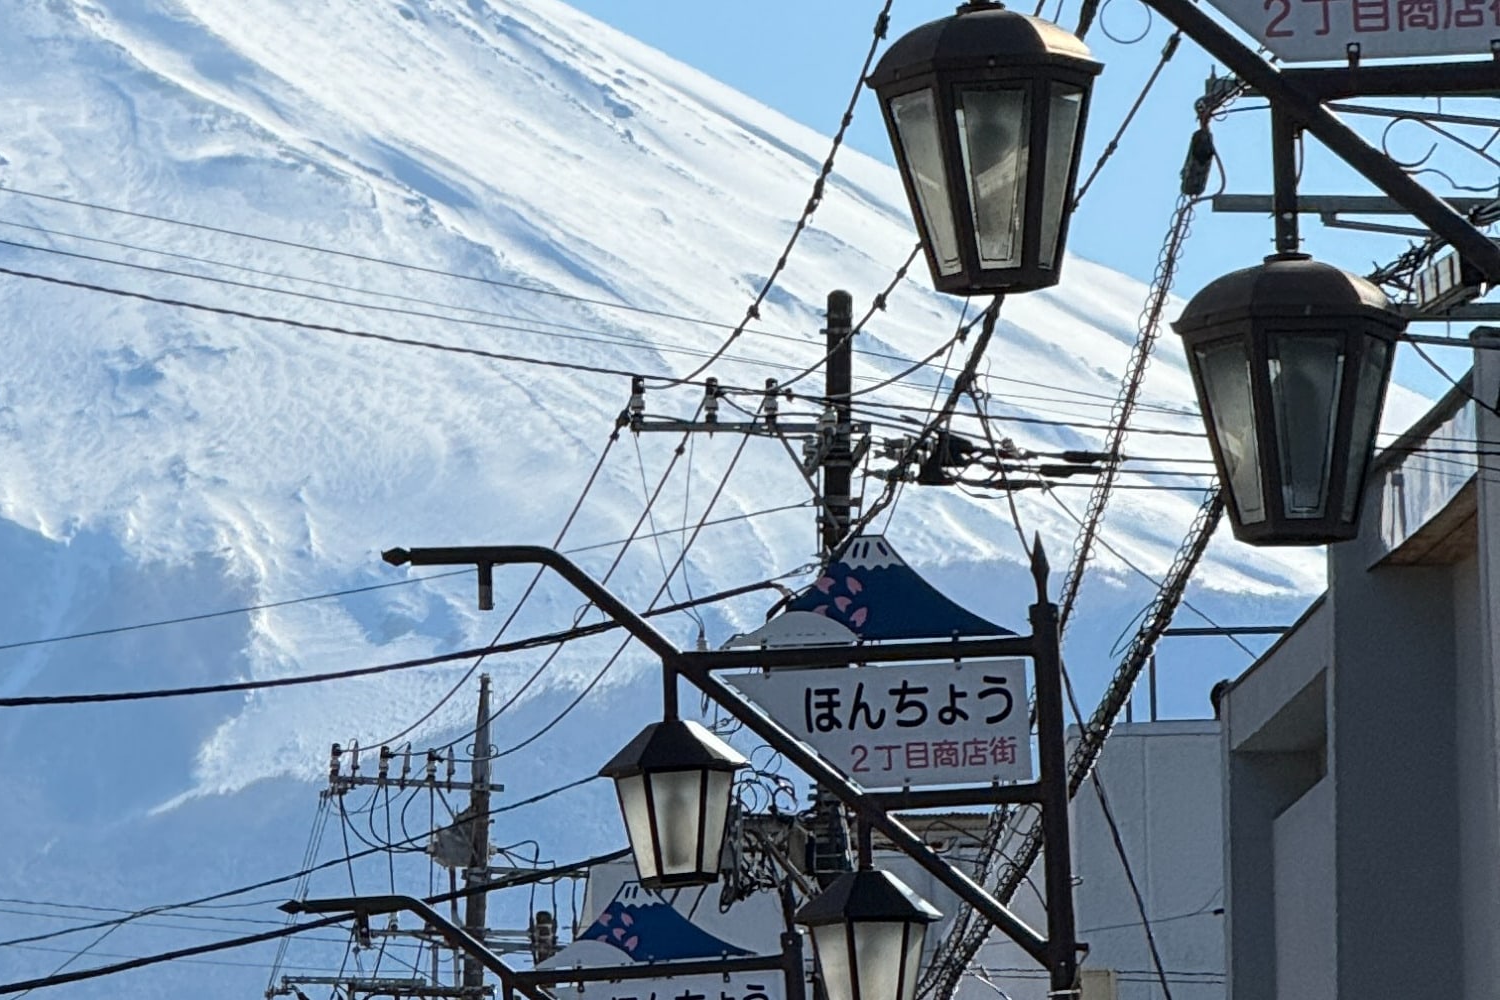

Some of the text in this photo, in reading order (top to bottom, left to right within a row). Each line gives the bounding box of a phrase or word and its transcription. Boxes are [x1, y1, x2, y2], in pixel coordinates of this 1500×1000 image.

[1263, 0, 1500, 38] 2丁目商店
[805, 675, 1013, 733] ほんちょう
[851, 736, 1018, 772] 2丁目商店街
